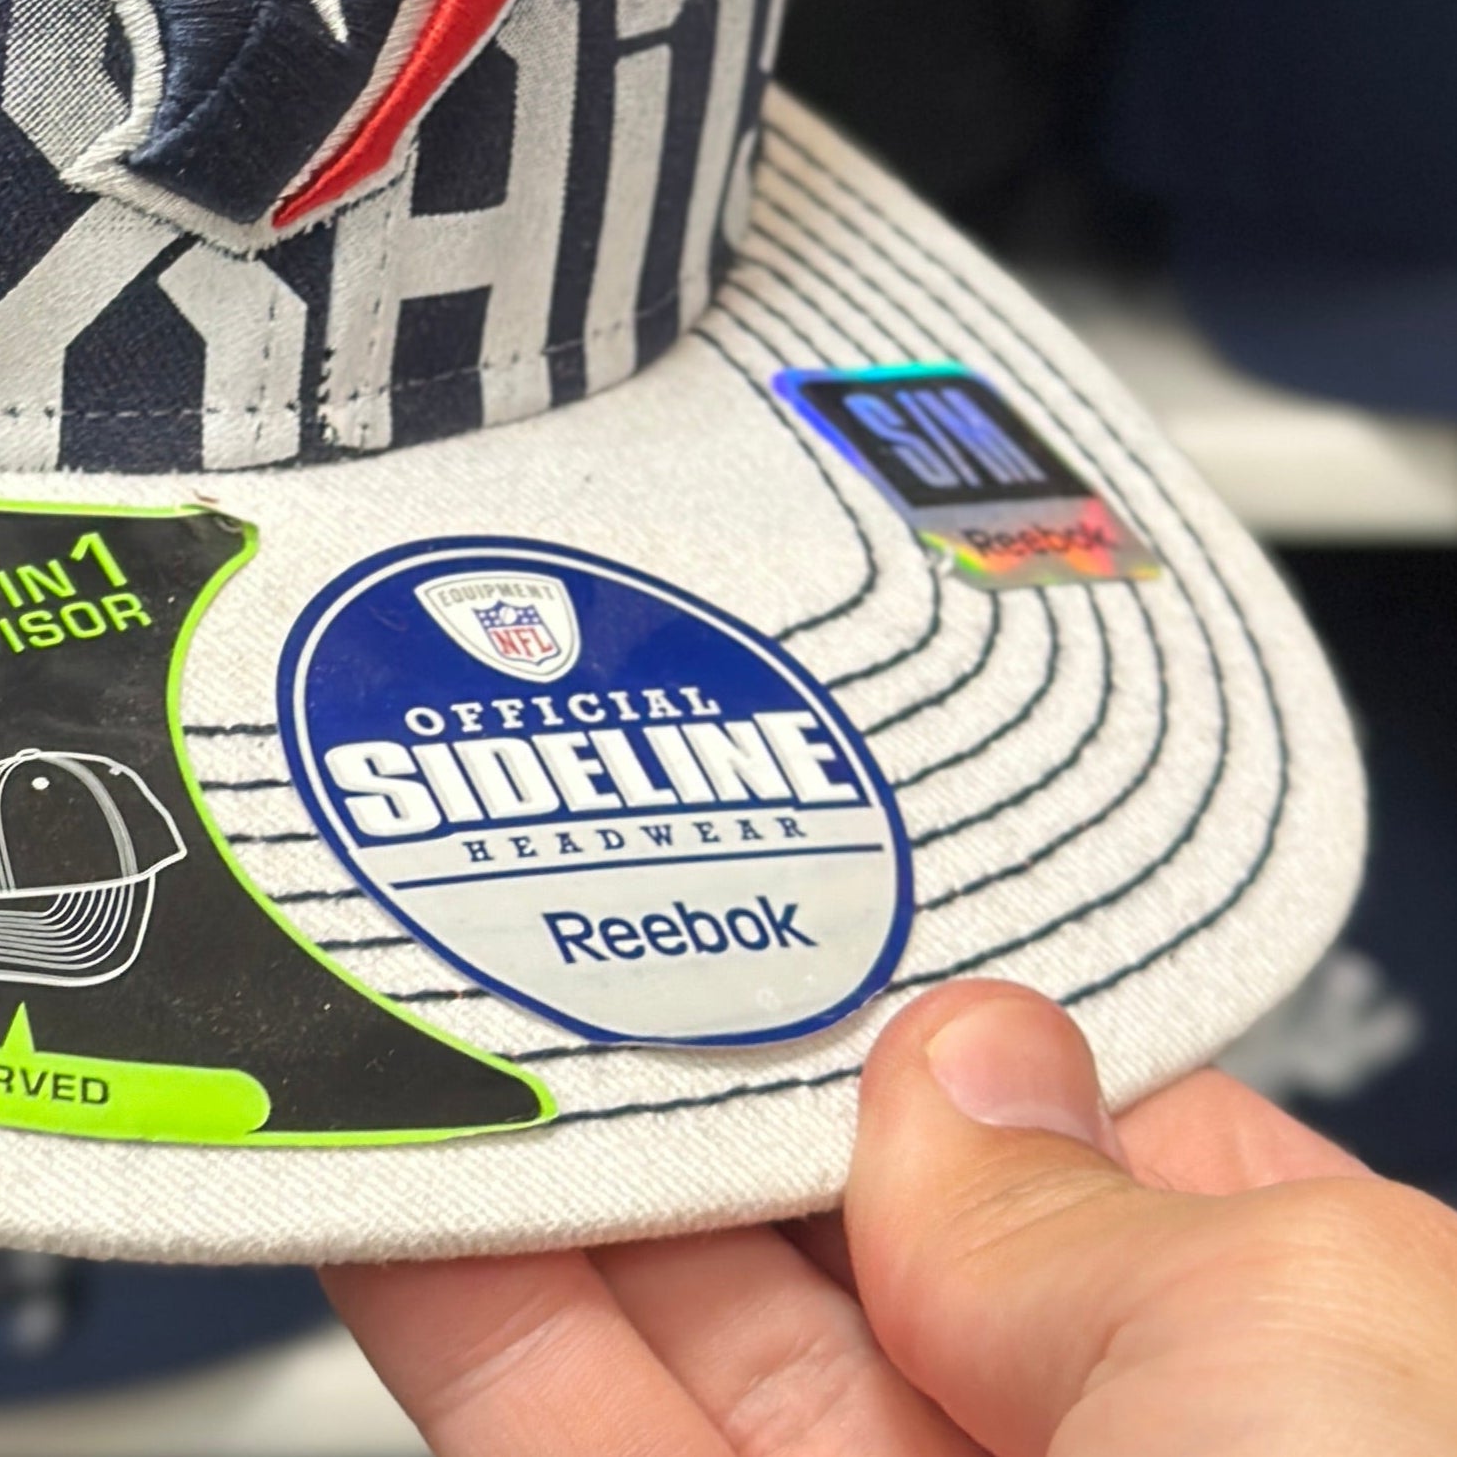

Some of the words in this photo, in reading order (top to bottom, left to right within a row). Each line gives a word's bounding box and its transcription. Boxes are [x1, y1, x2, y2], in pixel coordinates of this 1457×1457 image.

[844, 386, 1046, 489] S/M
[71, 532, 130, 588] 1
[962, 522, 1118, 558] Reebok
[438, 582, 555, 607] EQUIPMENT
[493, 627, 554, 657] NFL
[404, 686, 720, 737] OFFICIAL
[324, 711, 858, 838] SIDELINE
[463, 816, 806, 862] HEADWEAR
[543, 896, 818, 964] Reebok
